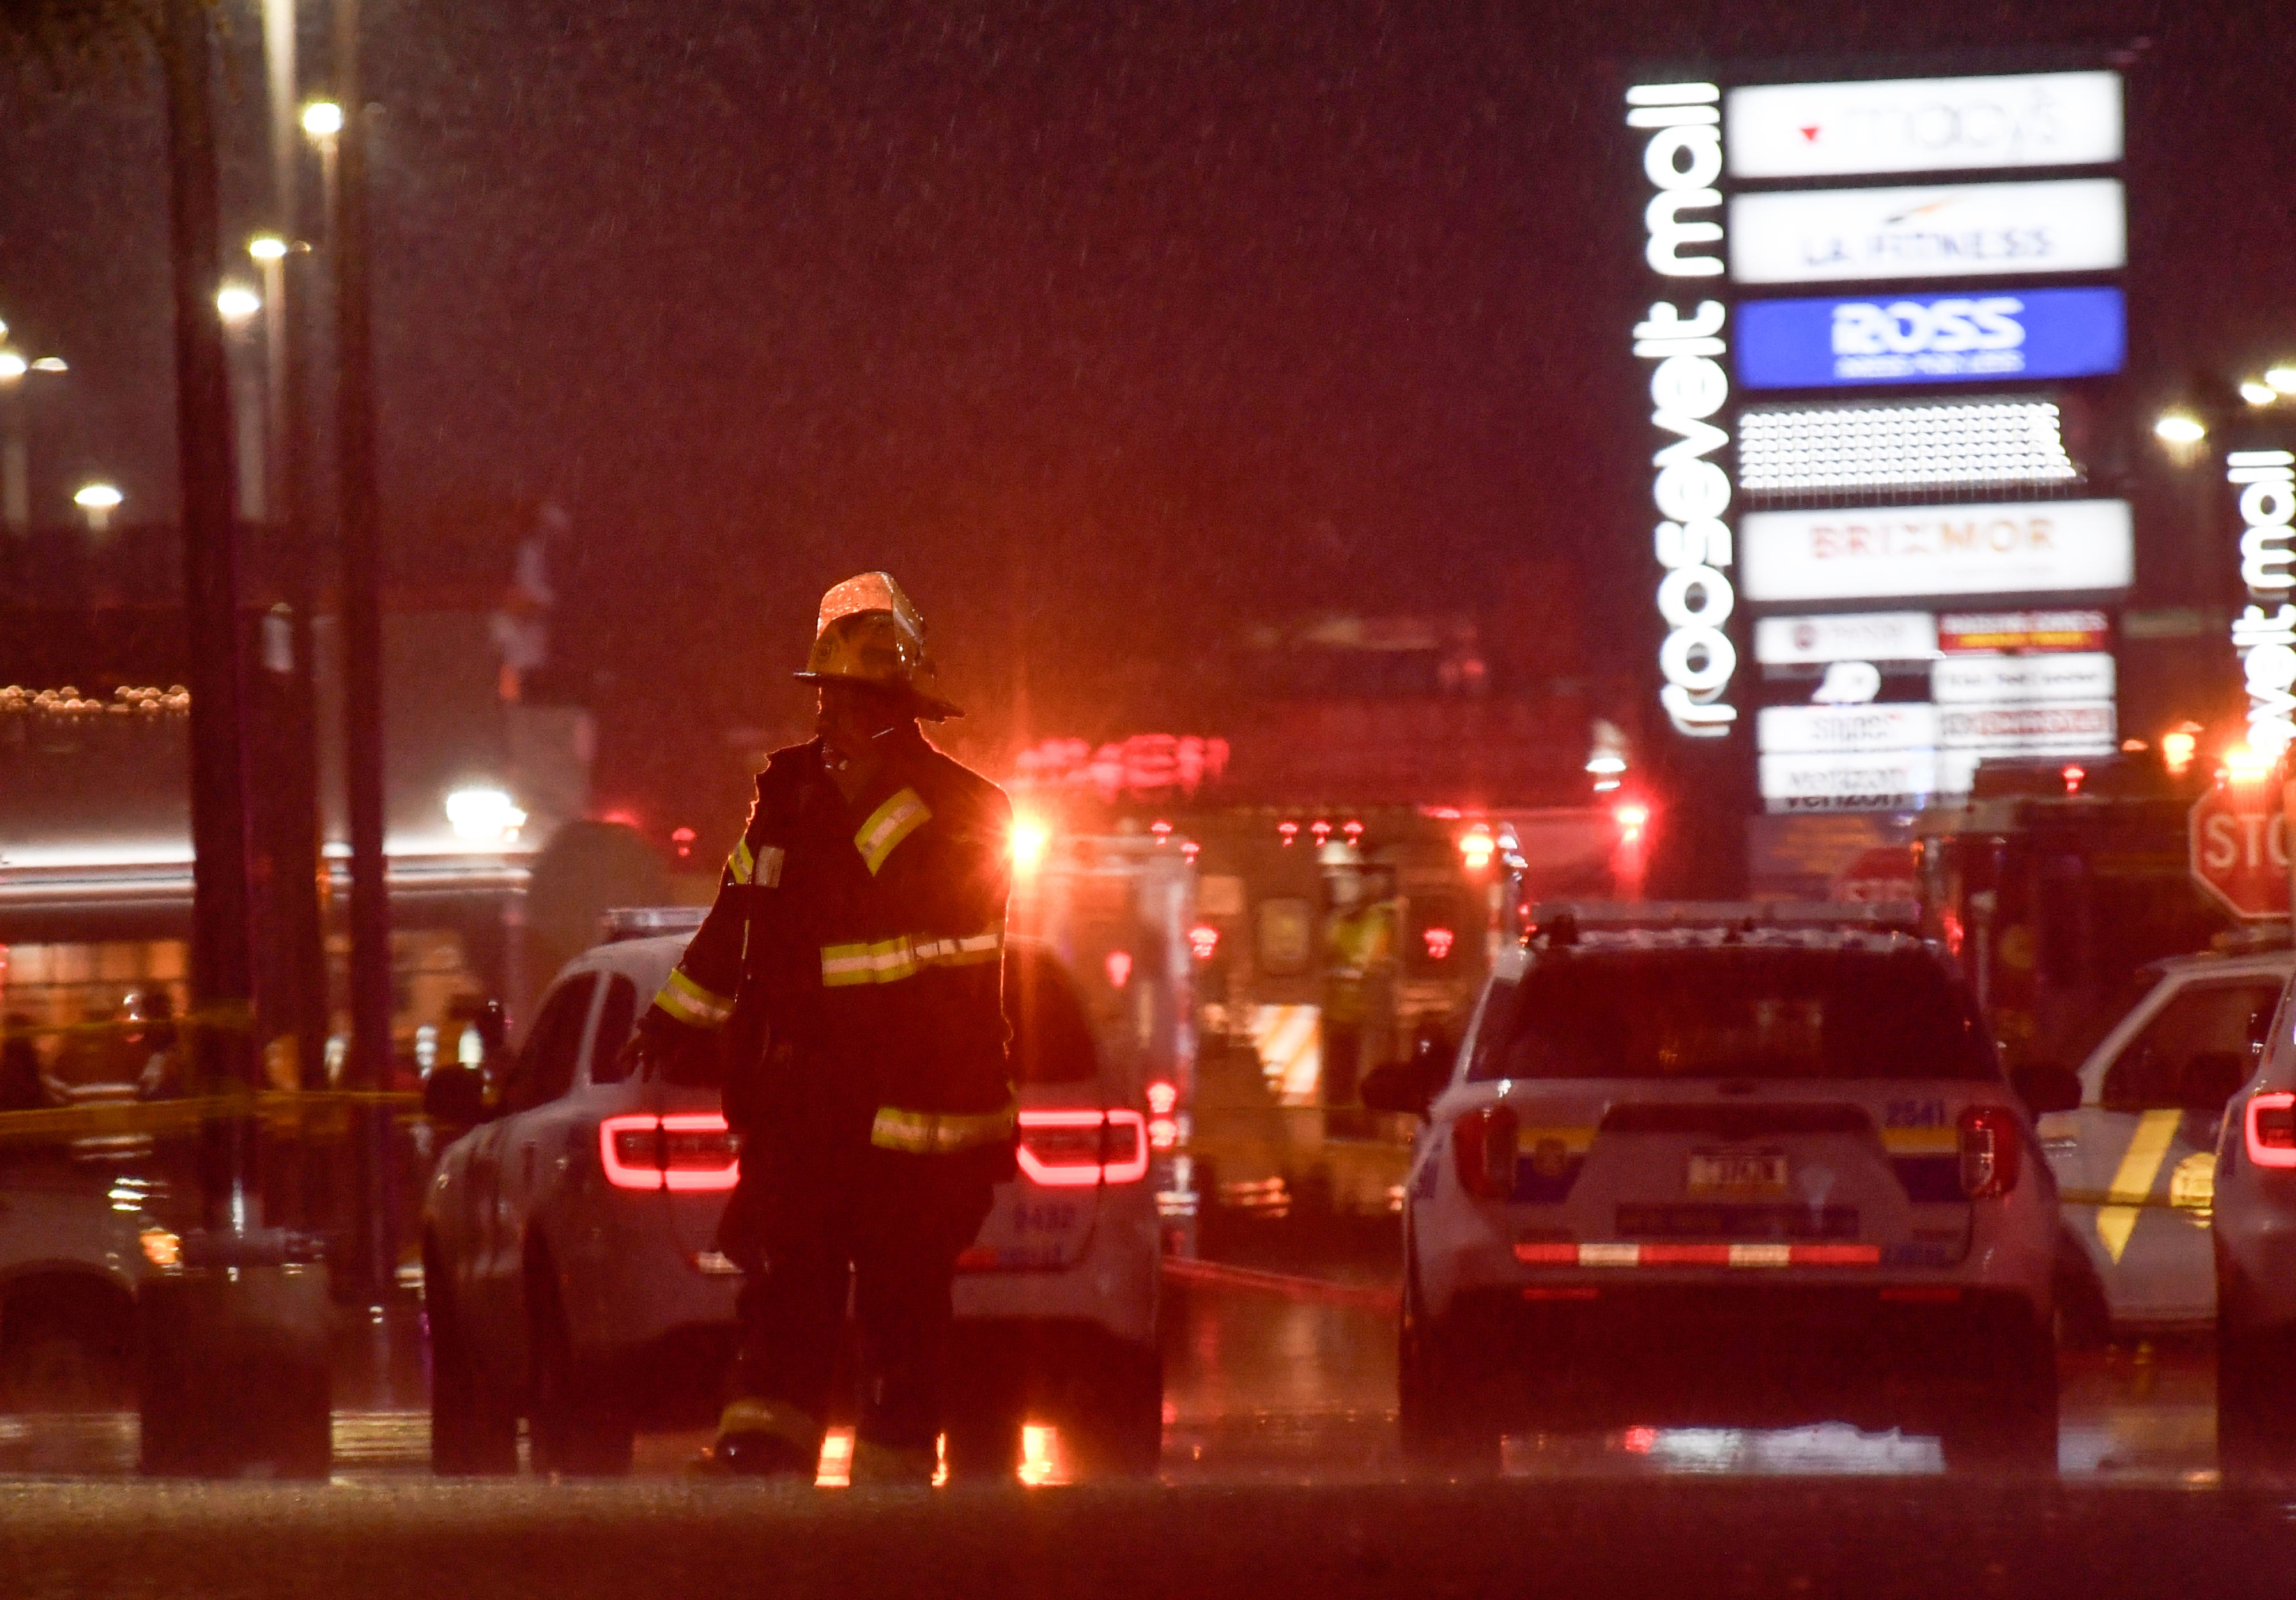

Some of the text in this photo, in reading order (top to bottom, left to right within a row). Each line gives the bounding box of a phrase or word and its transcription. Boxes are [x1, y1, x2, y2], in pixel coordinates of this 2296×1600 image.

[1832, 297, 2026, 355] ROSS
[1626, 82, 1737, 737] roosevelt mall
[1809, 516, 2056, 560] BRIXMOR
[2226, 450, 2296, 589] mall
[2204, 812, 2291, 868] STO
